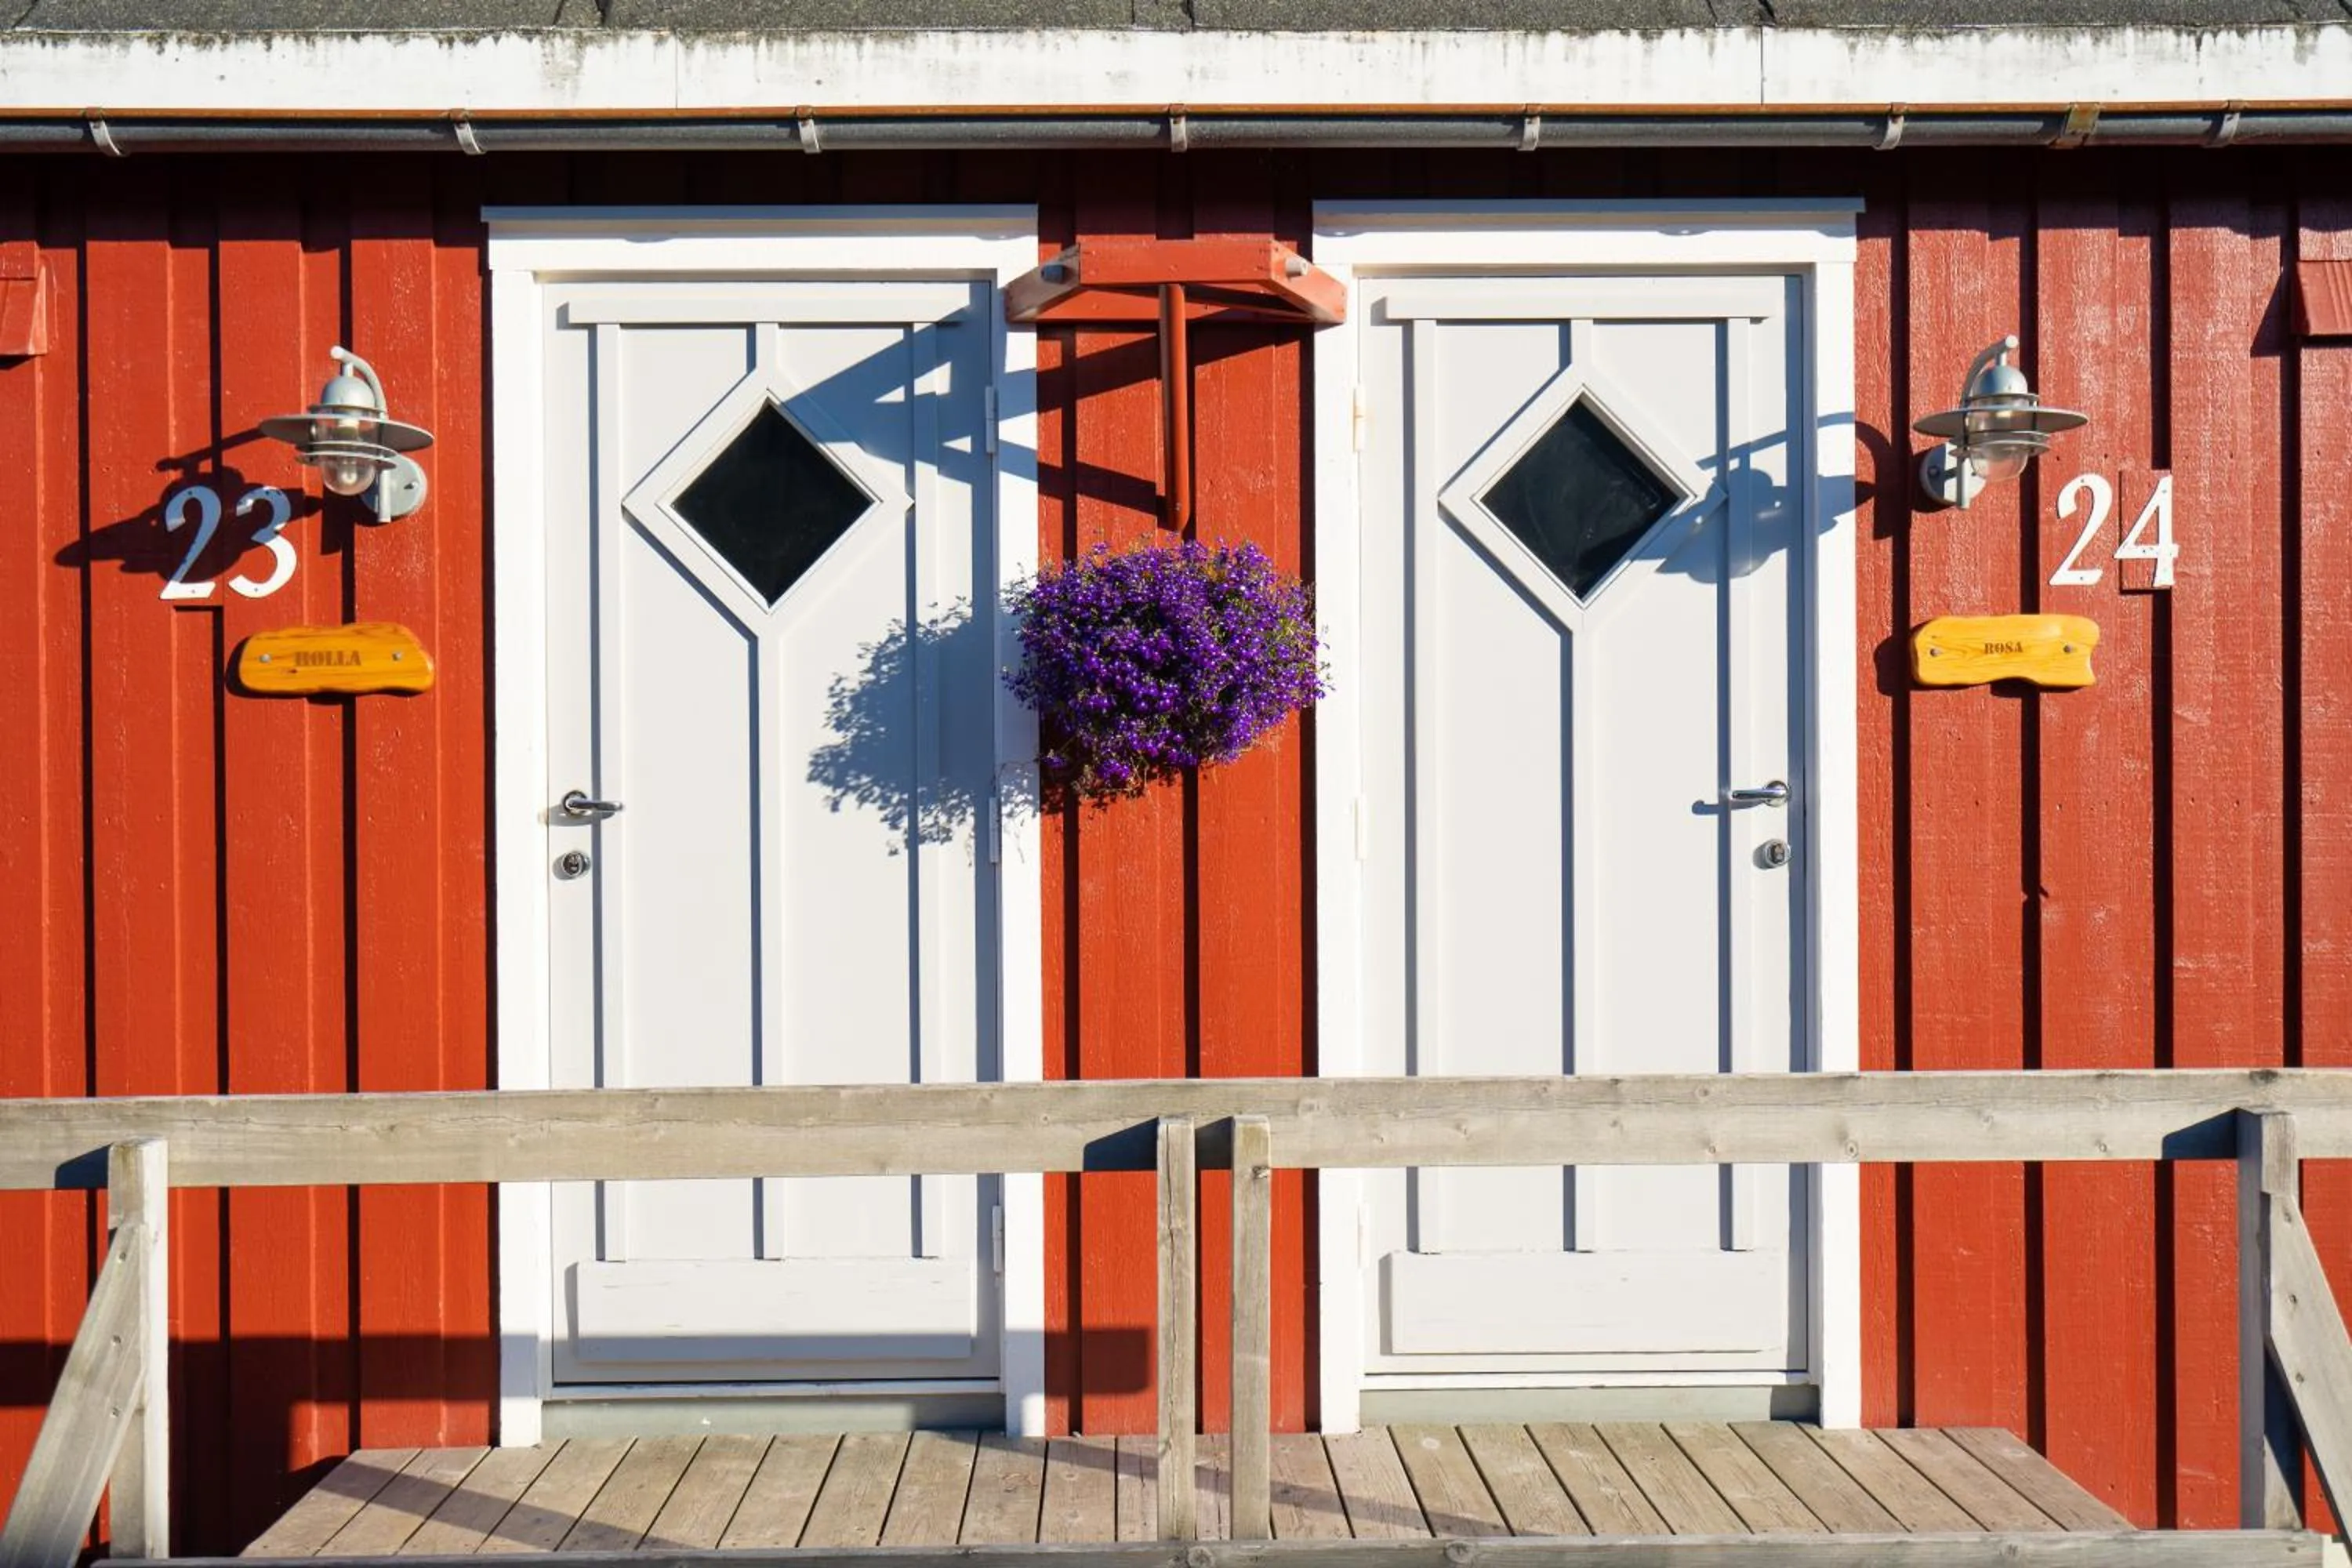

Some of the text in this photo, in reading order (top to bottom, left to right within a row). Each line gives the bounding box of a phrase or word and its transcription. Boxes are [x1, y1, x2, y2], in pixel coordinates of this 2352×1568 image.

[159, 485, 297, 600] 23
[2049, 474, 2180, 587] 24
[1984, 641, 2024, 655] ROSA
